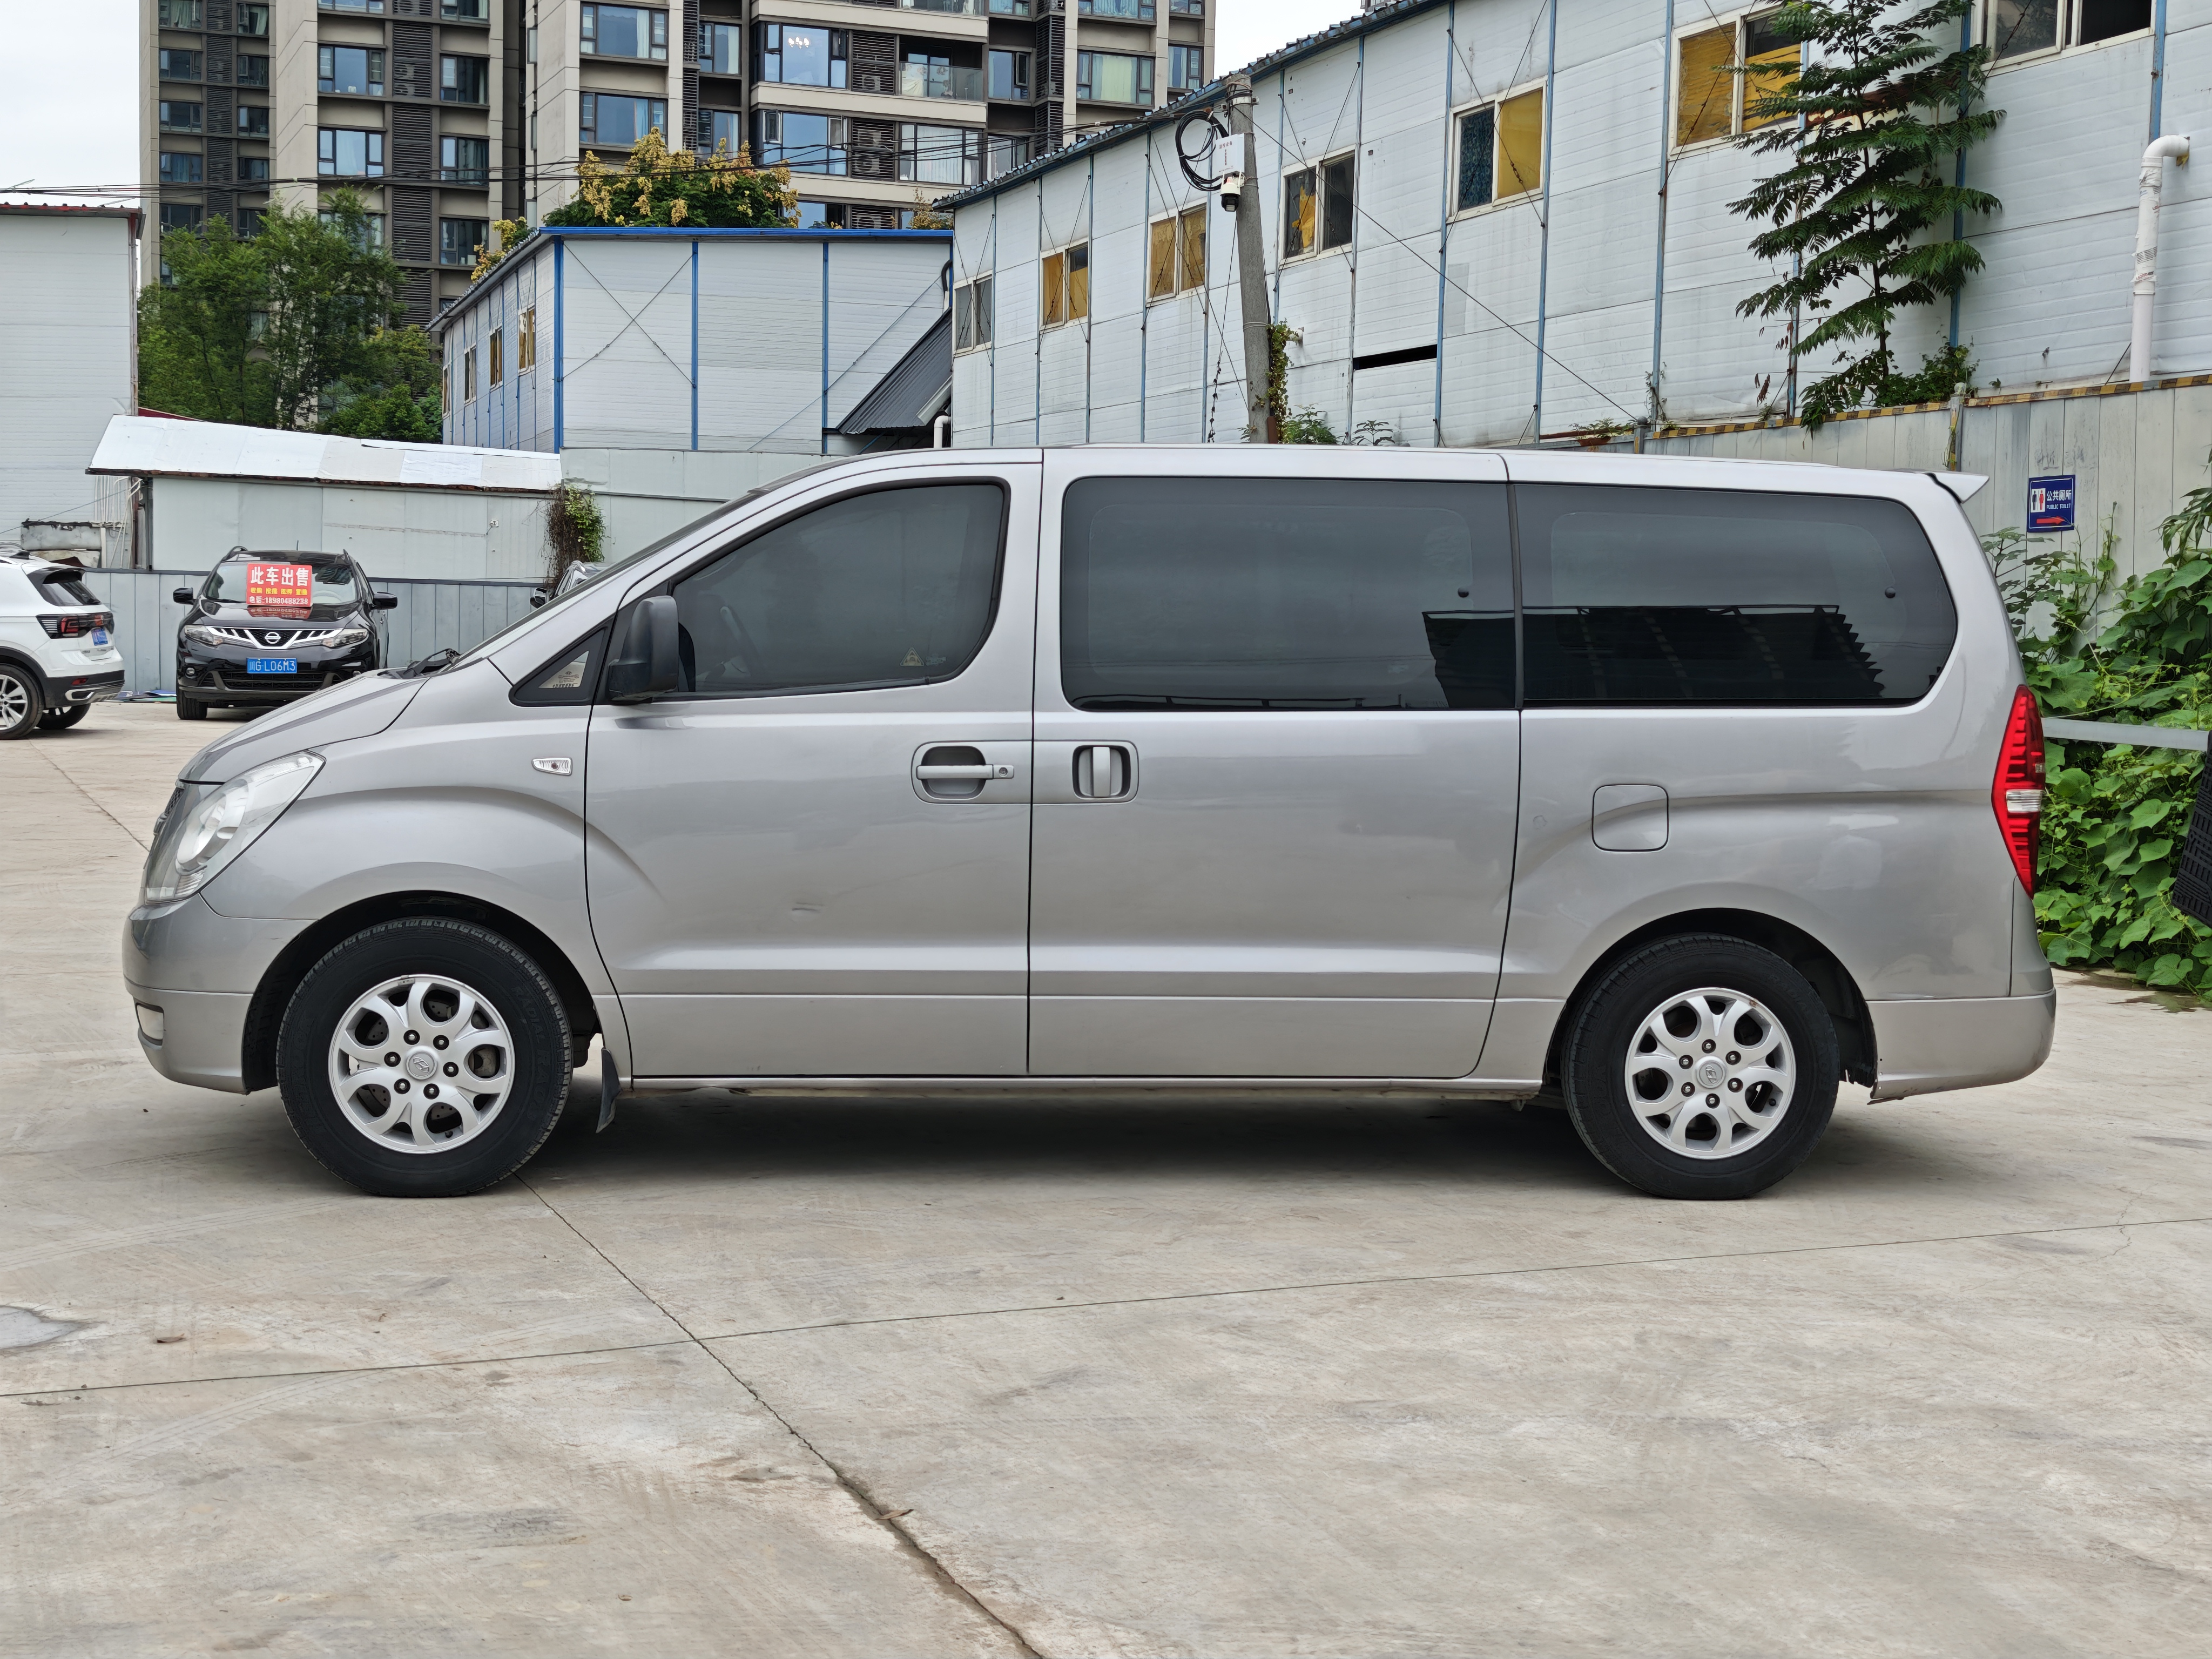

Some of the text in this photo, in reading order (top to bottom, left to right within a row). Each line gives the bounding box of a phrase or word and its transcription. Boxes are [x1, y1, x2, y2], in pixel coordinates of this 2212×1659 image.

[2047, 490, 2072, 501] 公共厕所
[251, 566, 308, 586] 此车出售
